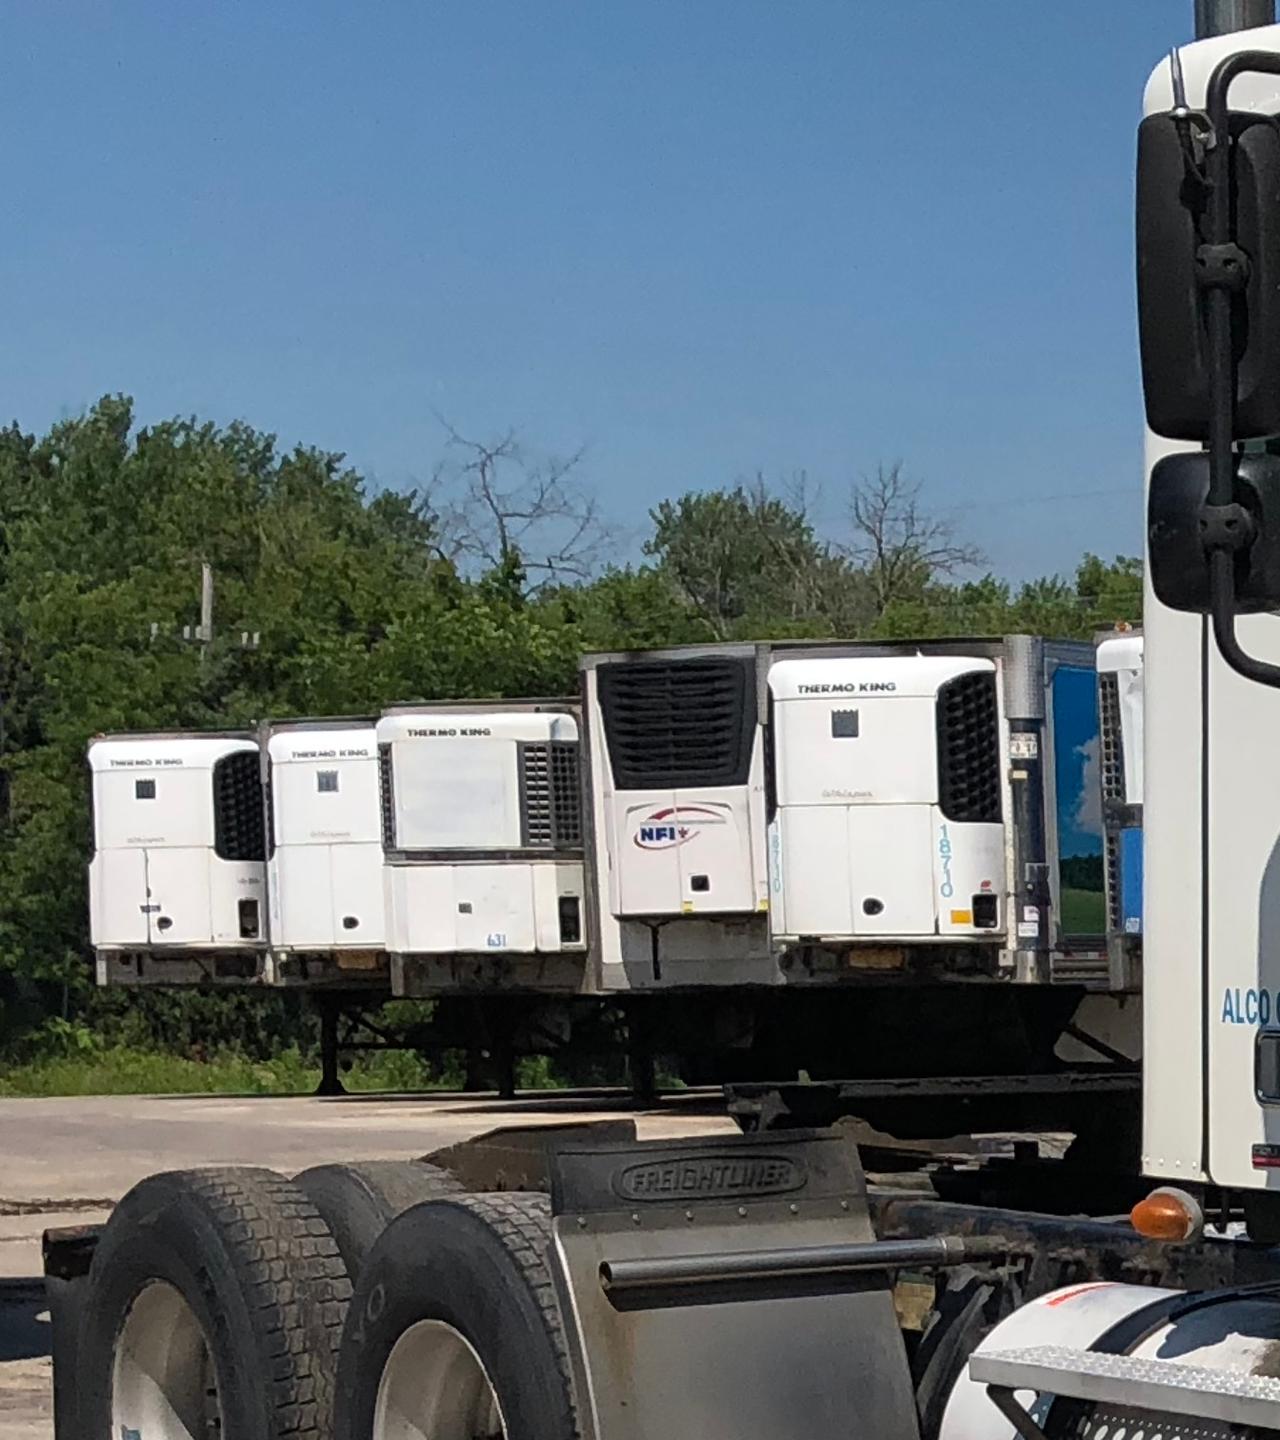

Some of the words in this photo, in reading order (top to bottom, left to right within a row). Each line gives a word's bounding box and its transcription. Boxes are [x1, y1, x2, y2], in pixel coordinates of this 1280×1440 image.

[798, 684, 855, 694] THERMO
[859, 682, 897, 692] KING
[407, 729, 457, 737] THERMO
[460, 728, 491, 736] KING
[641, 827, 676, 842] NFI
[1221, 988, 1271, 1025] ALCO
